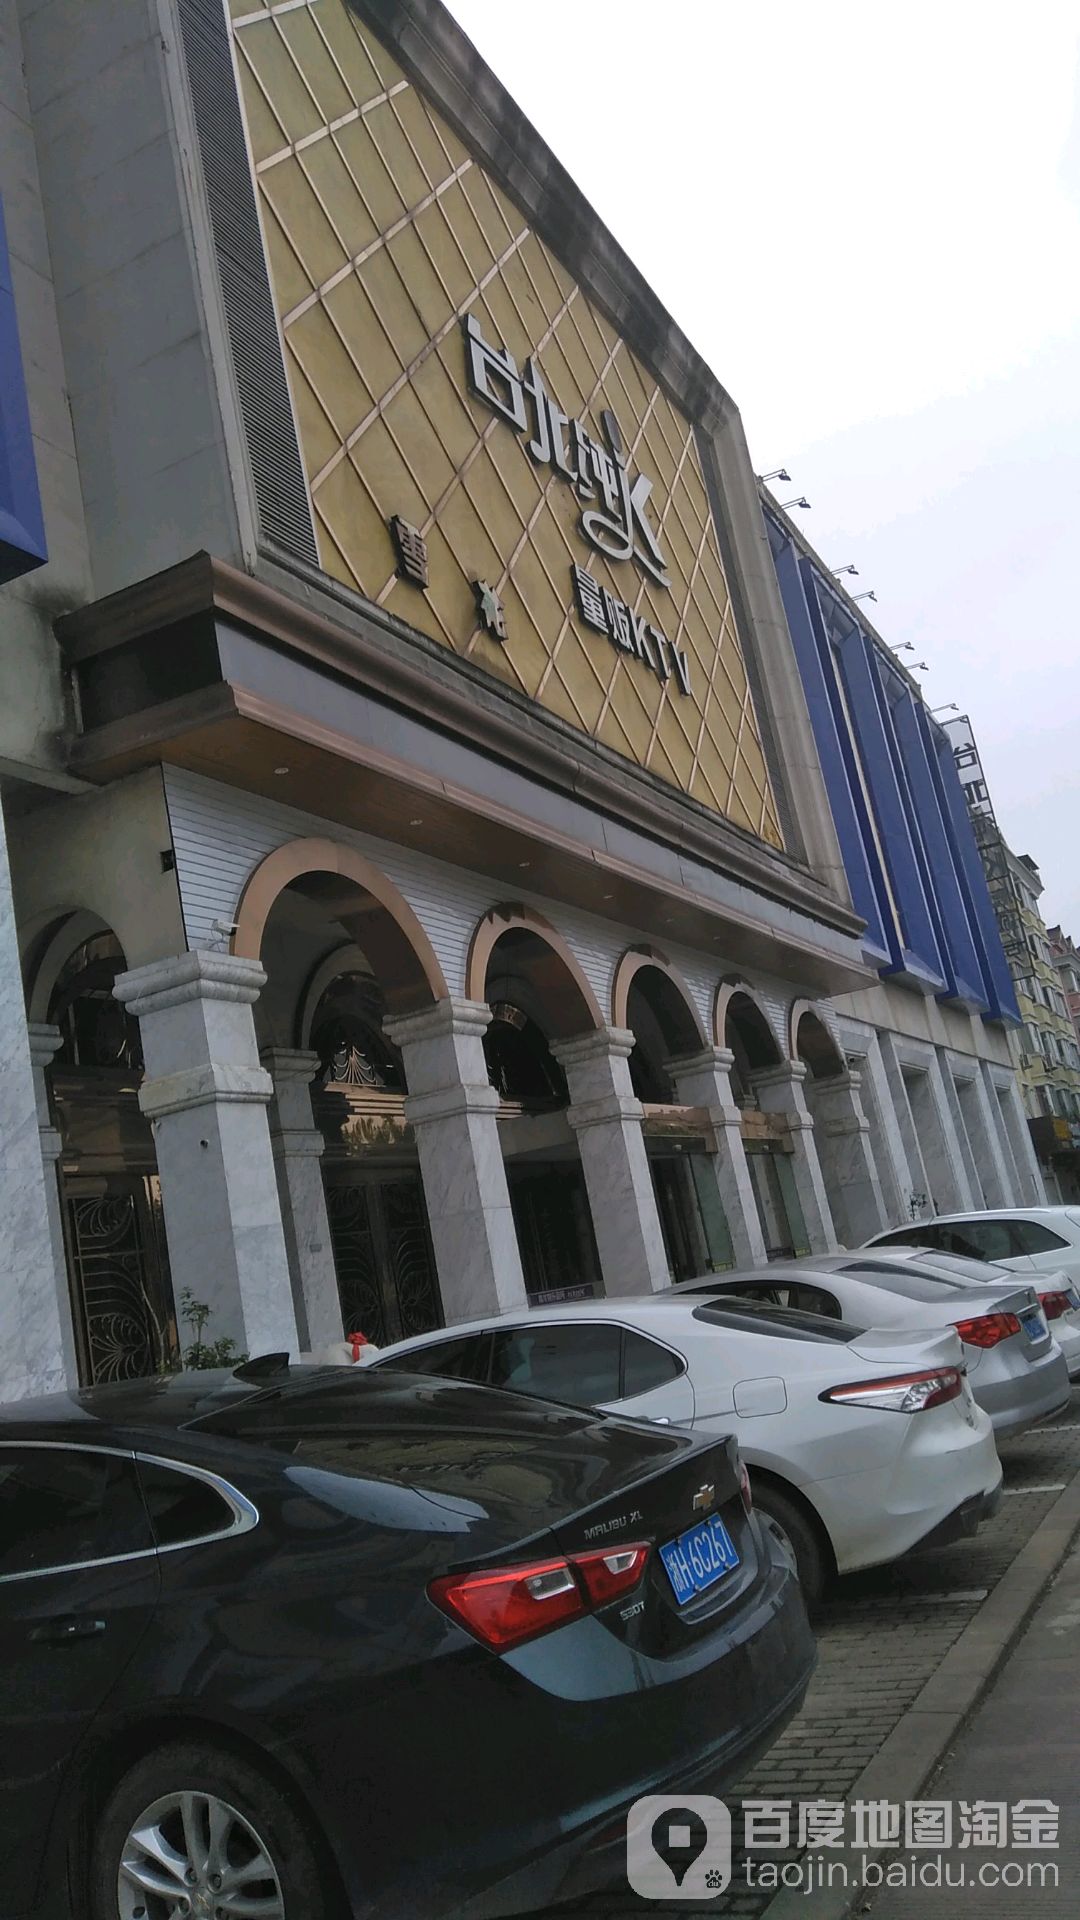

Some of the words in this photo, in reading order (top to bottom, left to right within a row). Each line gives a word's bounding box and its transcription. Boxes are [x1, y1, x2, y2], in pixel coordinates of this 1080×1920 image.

[571, 562, 691, 697] 量贩KTV
[584, 1515, 627, 1540] MALIBU
[630, 1510, 643, 1523] XL
